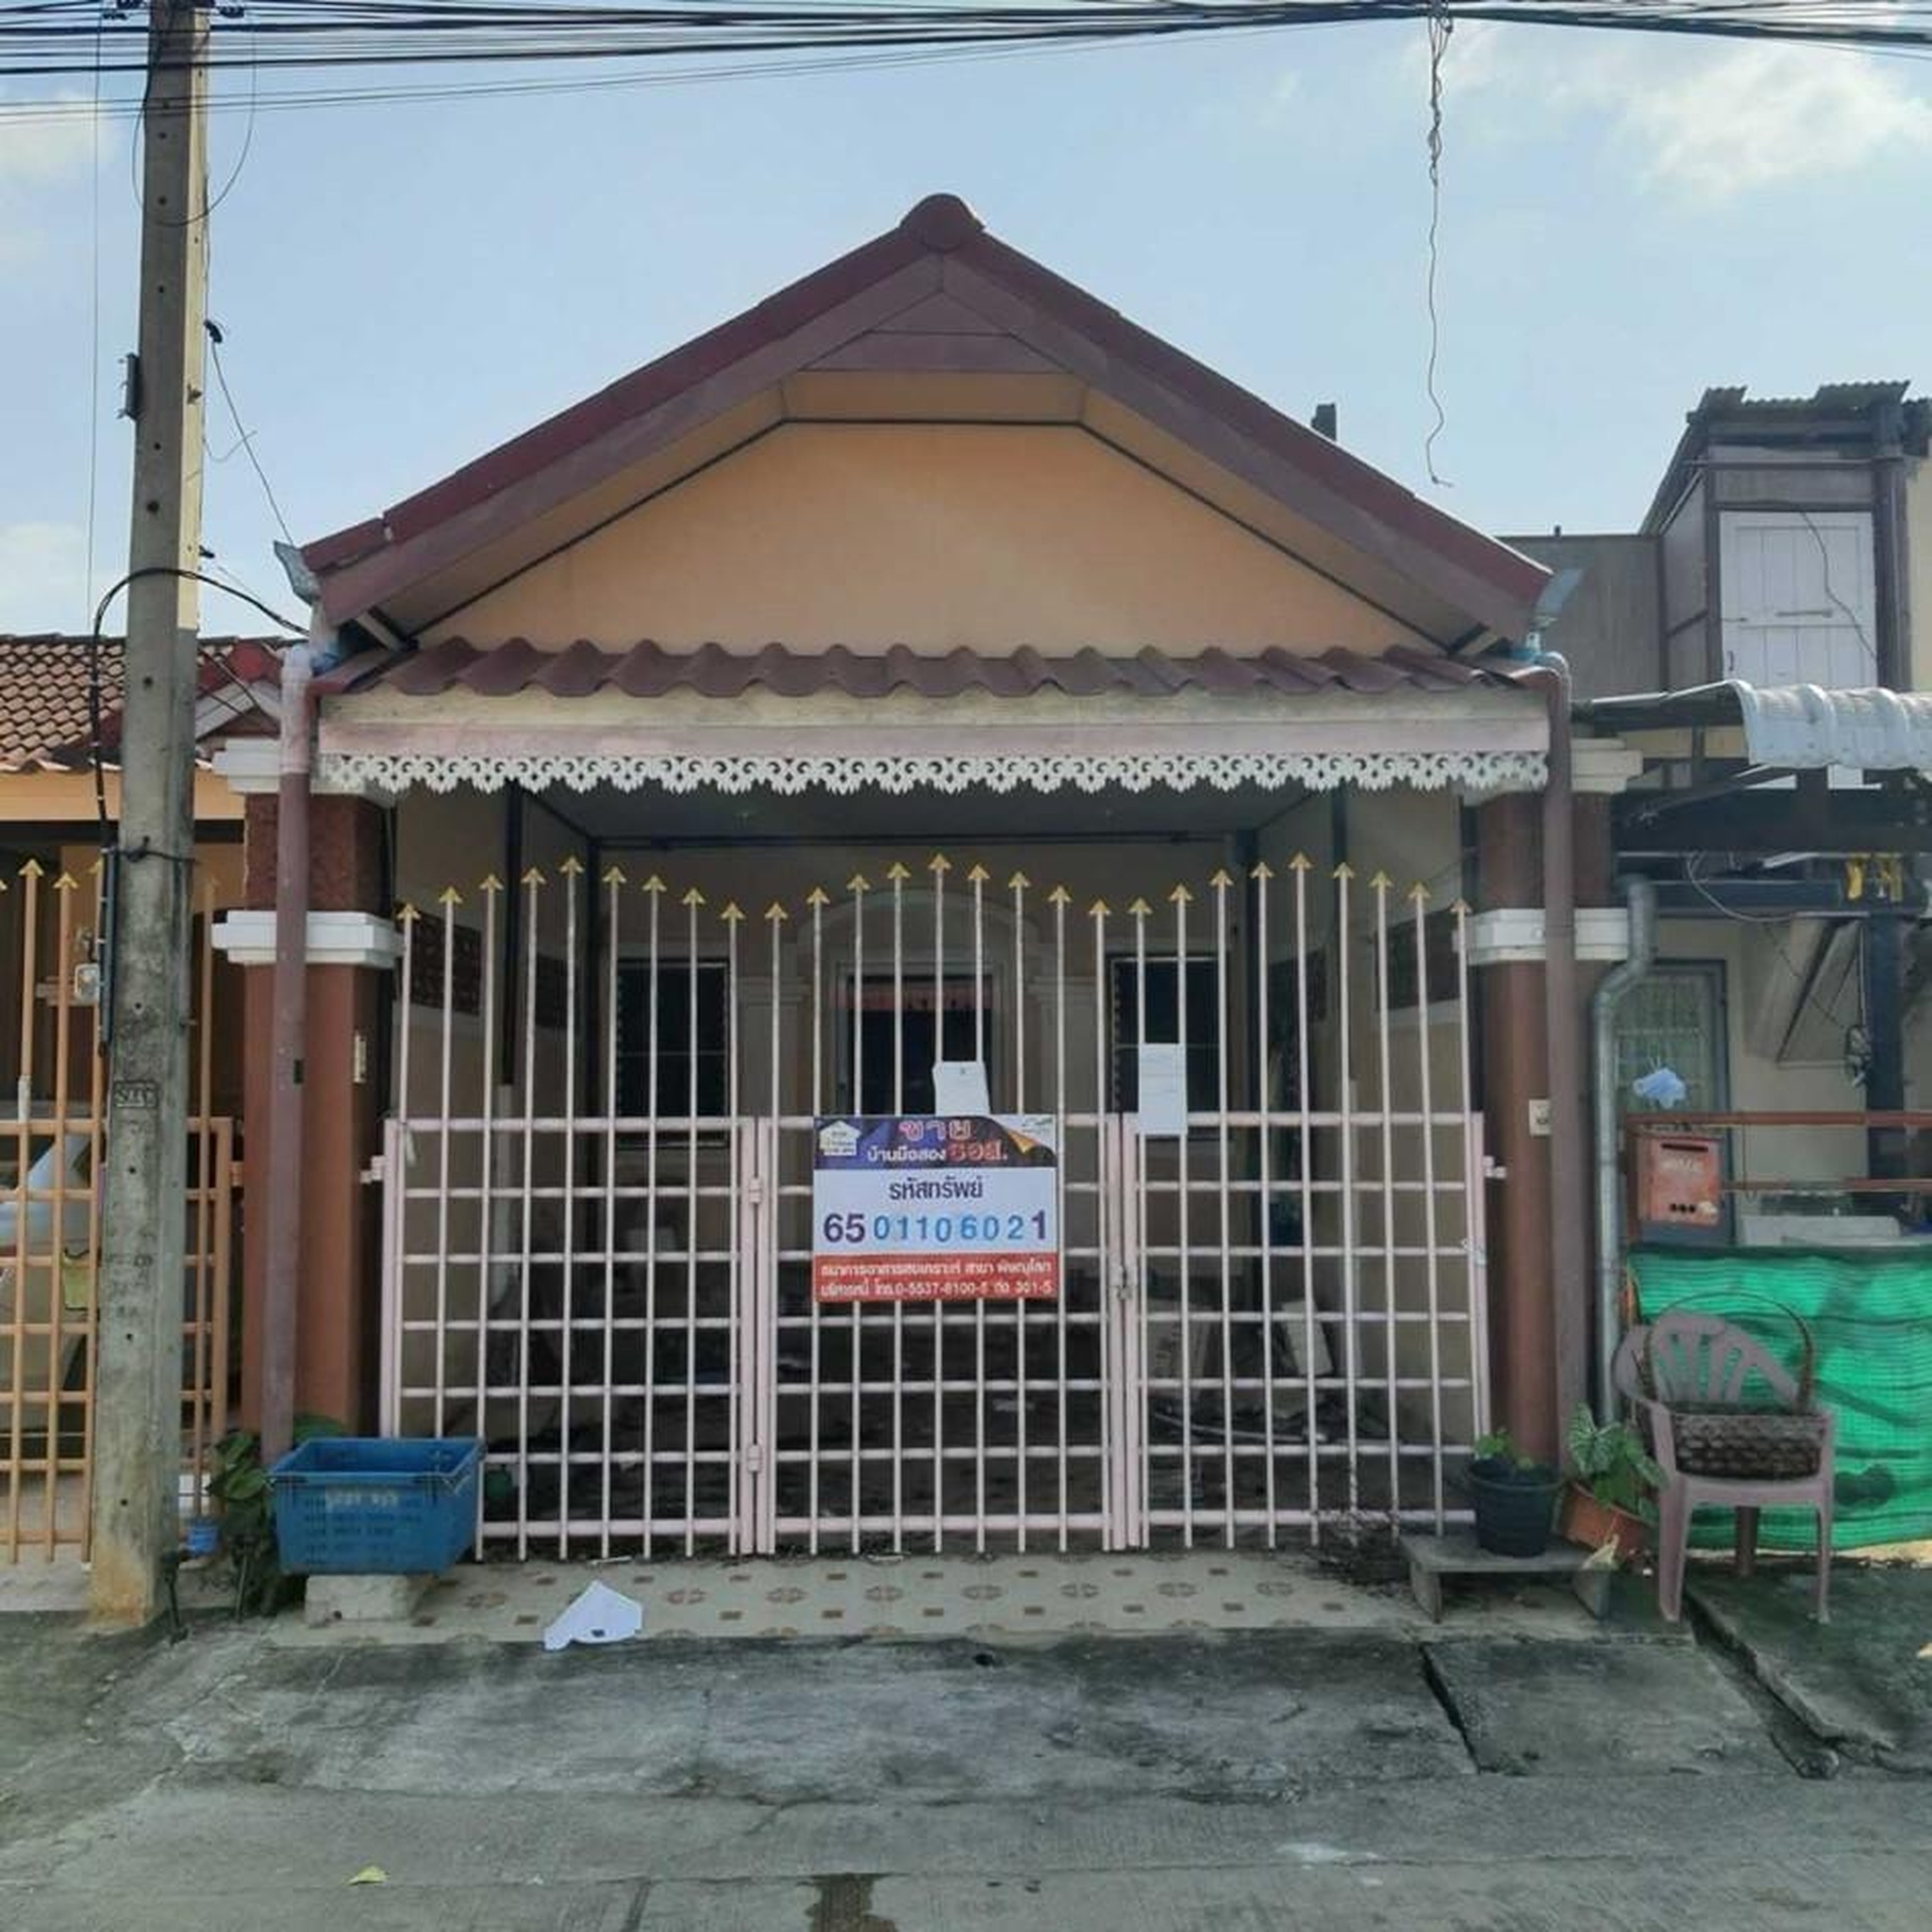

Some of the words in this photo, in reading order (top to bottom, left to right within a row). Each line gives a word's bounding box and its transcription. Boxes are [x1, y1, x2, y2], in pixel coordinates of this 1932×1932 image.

[899, 1120, 972, 1141] ขาย
[867, 1143, 945, 1162] บ้านมือสอง
[890, 1176, 983, 1201] รหัสทรัพย์
